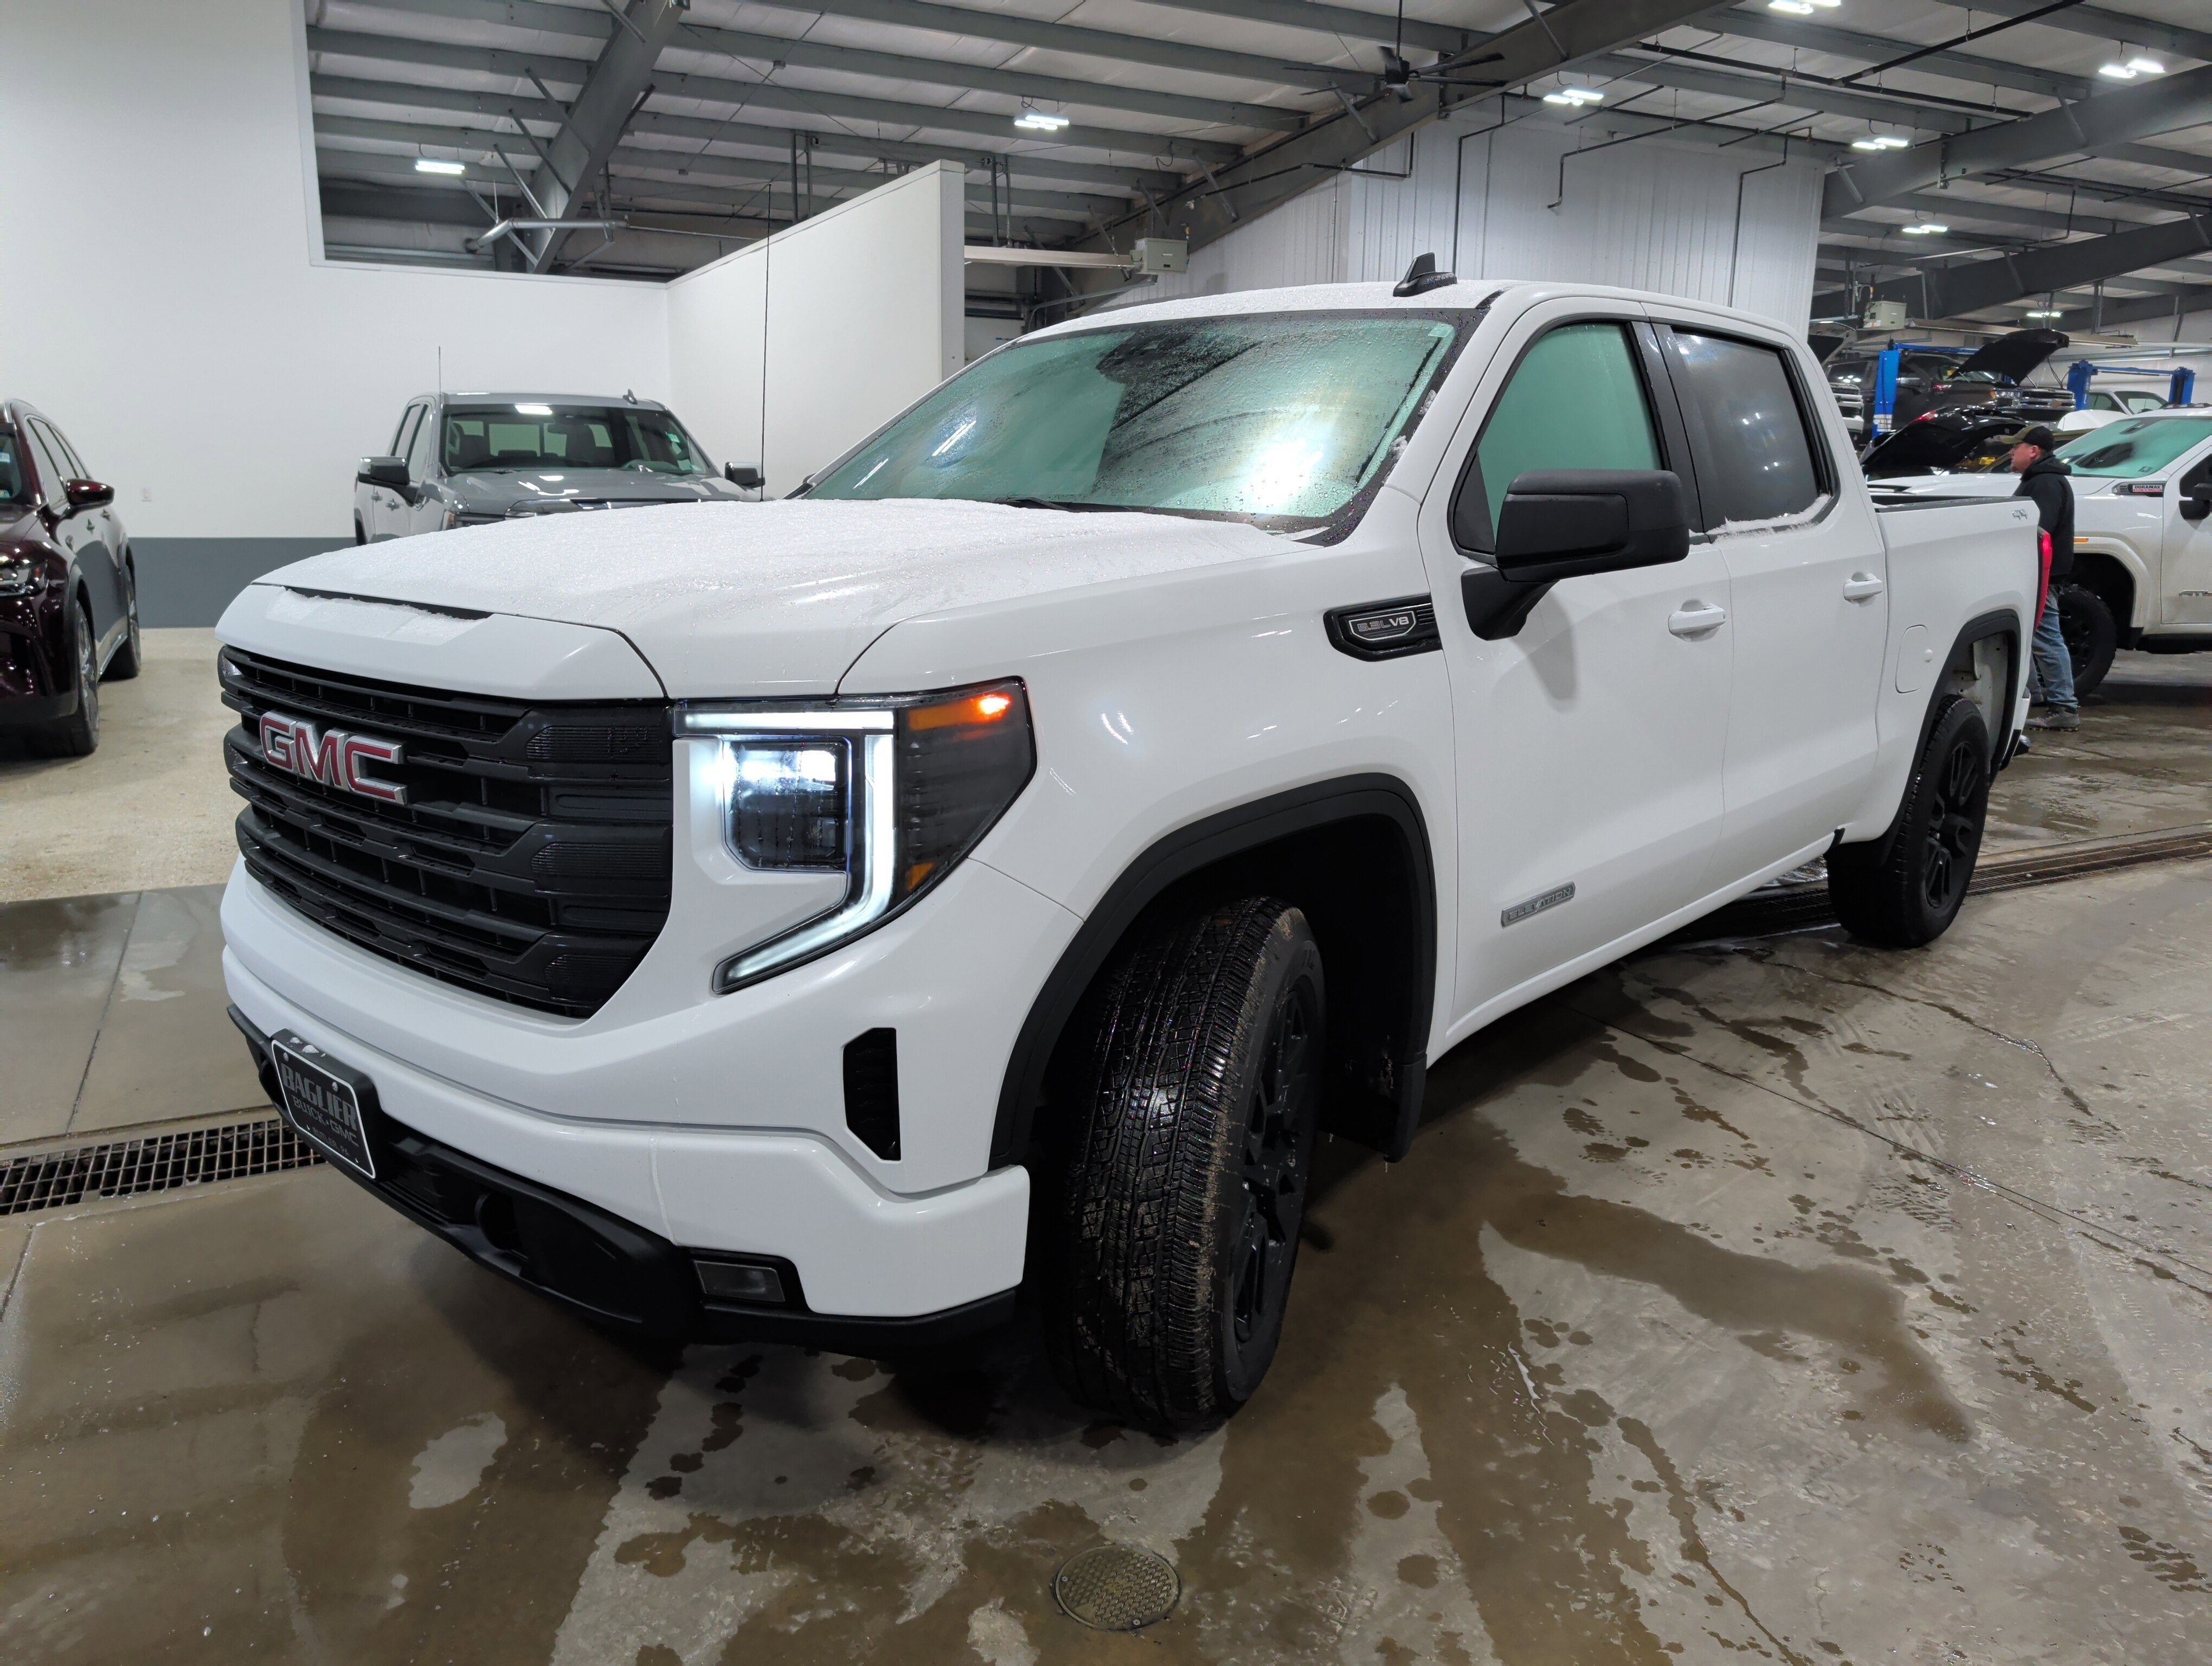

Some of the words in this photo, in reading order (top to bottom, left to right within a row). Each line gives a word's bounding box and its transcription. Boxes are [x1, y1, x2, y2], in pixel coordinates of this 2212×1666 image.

[260, 711, 407, 806] GMC
[1509, 887, 1571, 920] ELEVATION
[281, 1062, 357, 1132] BAGLIER
